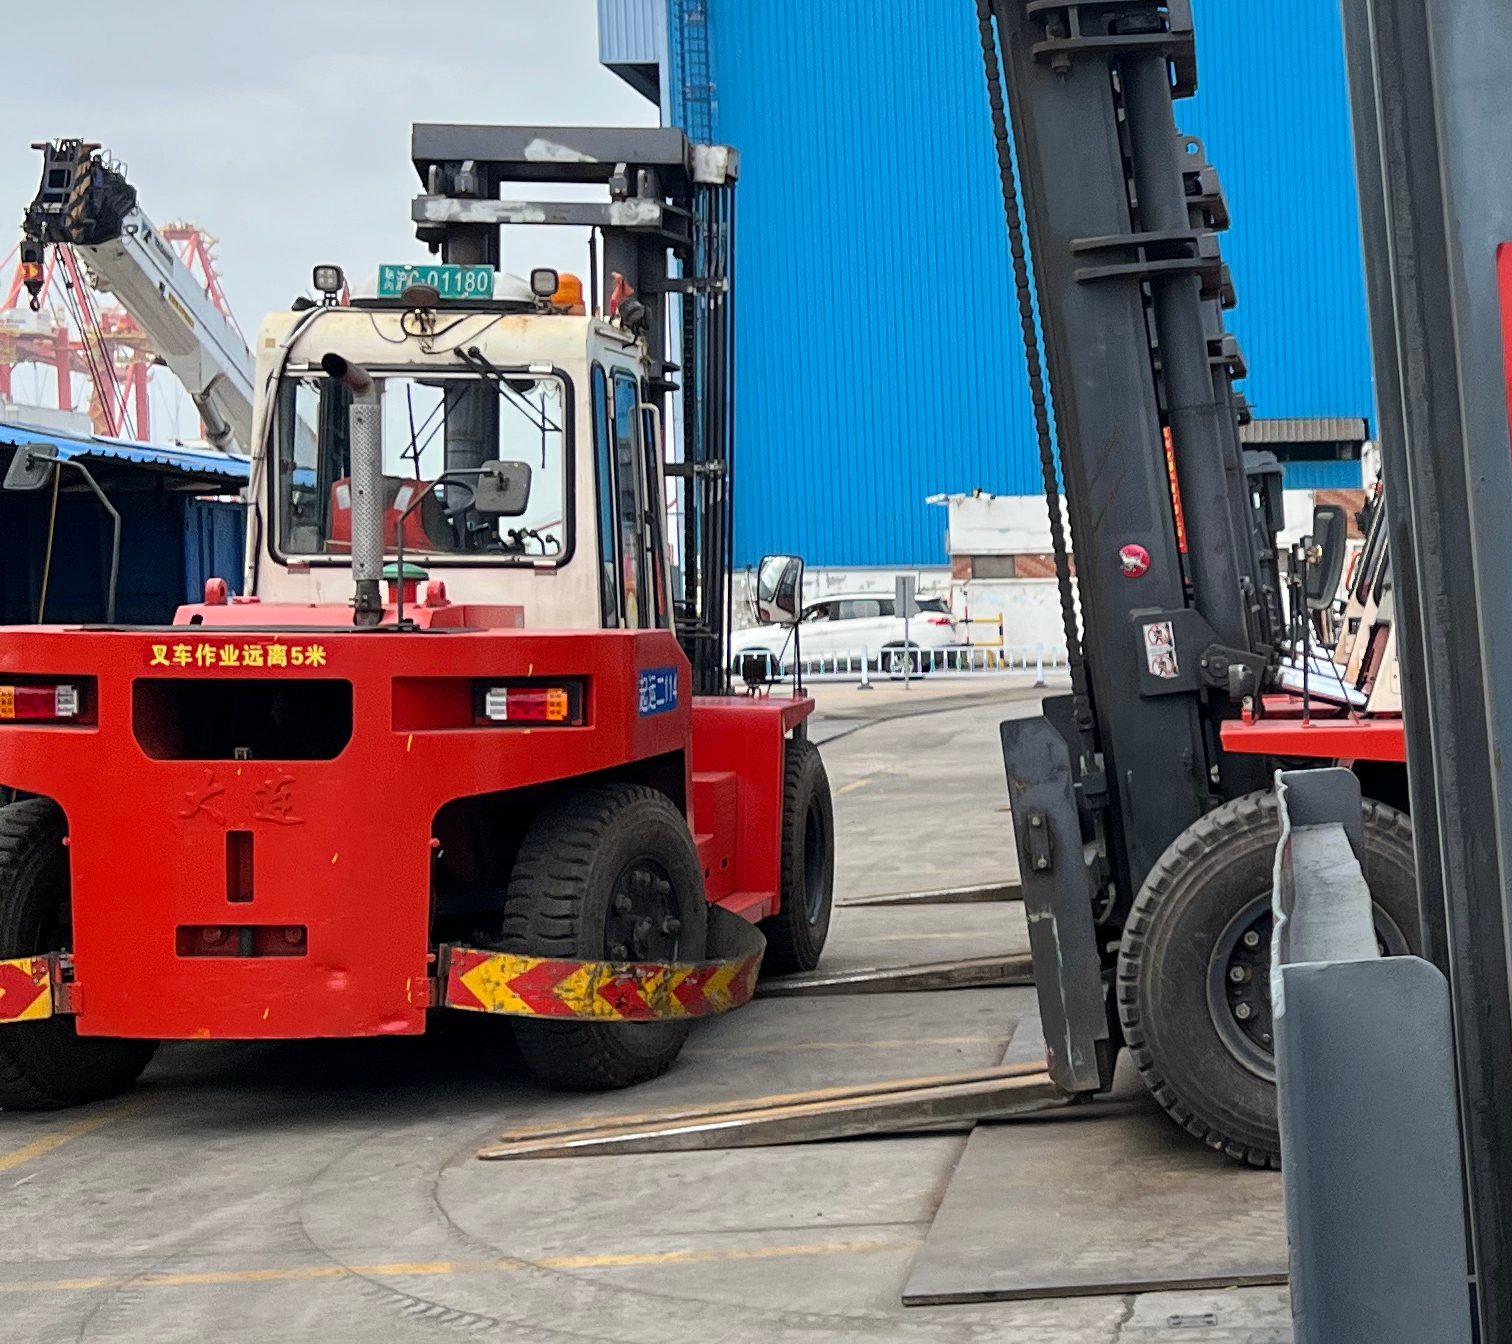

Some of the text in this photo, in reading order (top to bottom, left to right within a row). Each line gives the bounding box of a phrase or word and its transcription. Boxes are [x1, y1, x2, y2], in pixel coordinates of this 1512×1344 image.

[150, 643, 327, 667] 叉车作业远离5米
